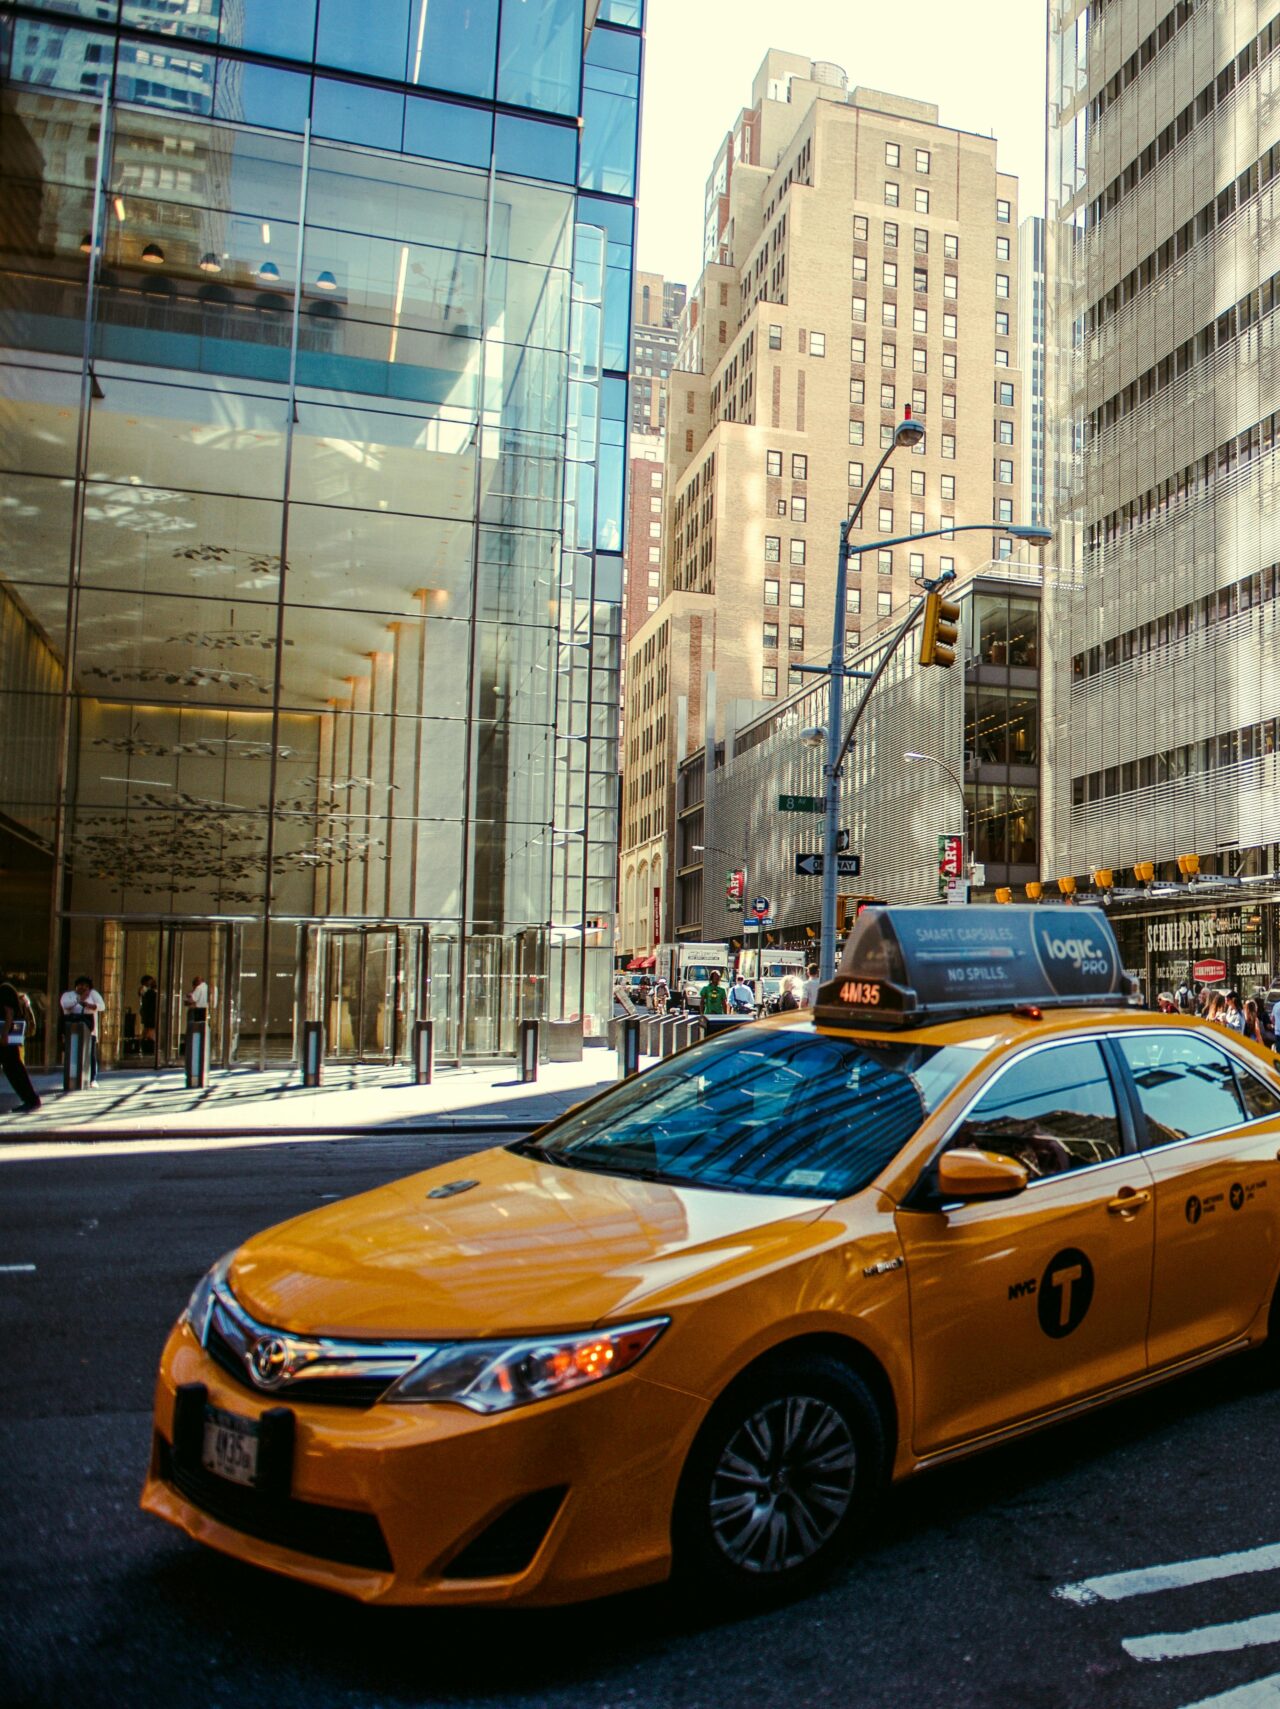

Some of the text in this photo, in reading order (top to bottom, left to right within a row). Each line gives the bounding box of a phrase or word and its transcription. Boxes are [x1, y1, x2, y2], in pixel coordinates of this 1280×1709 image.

[786, 797, 795, 809] 8
[945, 839, 957, 874] ART
[730, 872, 741, 896] ART
[916, 928, 955, 942] SMART
[1147, 919, 1215, 953] SCHNIPPER'S
[1216, 933, 1242, 947] KITCHEN
[1042, 930, 1103, 968] logic.
[947, 967, 1008, 981] NO SPILLS.
[1081, 960, 1108, 975] PRO
[1236, 963, 1250, 975] BEER
[839, 981, 881, 1005] 4M35
[1008, 1264, 1082, 1326] NYC T
